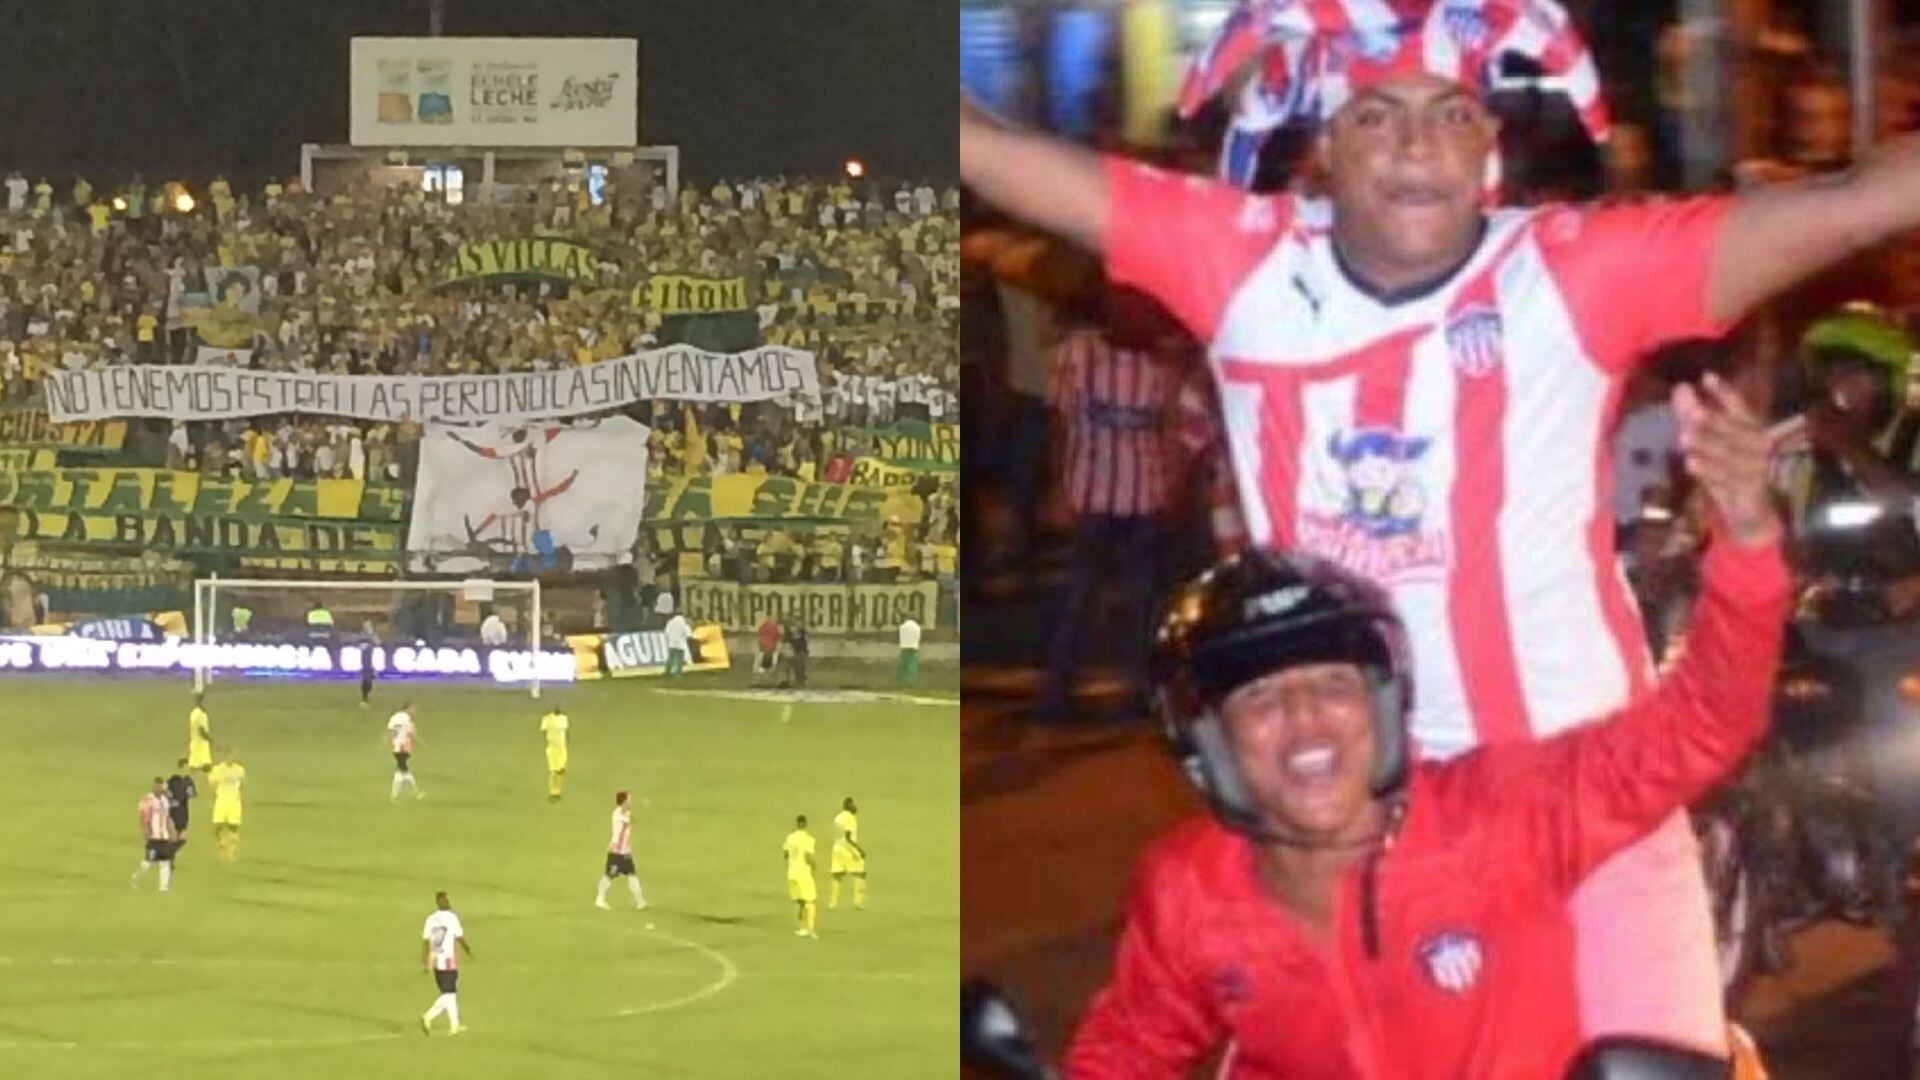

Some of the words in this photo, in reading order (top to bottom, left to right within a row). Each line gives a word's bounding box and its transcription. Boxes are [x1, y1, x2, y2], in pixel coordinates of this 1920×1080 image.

[470, 90, 538, 106] LECHE
[488, 241, 597, 280] VILLAS
[46, 371, 88, 414] NO
[97, 368, 230, 412] TENEMOS
[419, 377, 500, 416] PERO
[505, 375, 547, 413] NO
[547, 365, 610, 409] LAS
[613, 351, 803, 400] INVENTAMOS
[115, 513, 281, 549] BANDA
